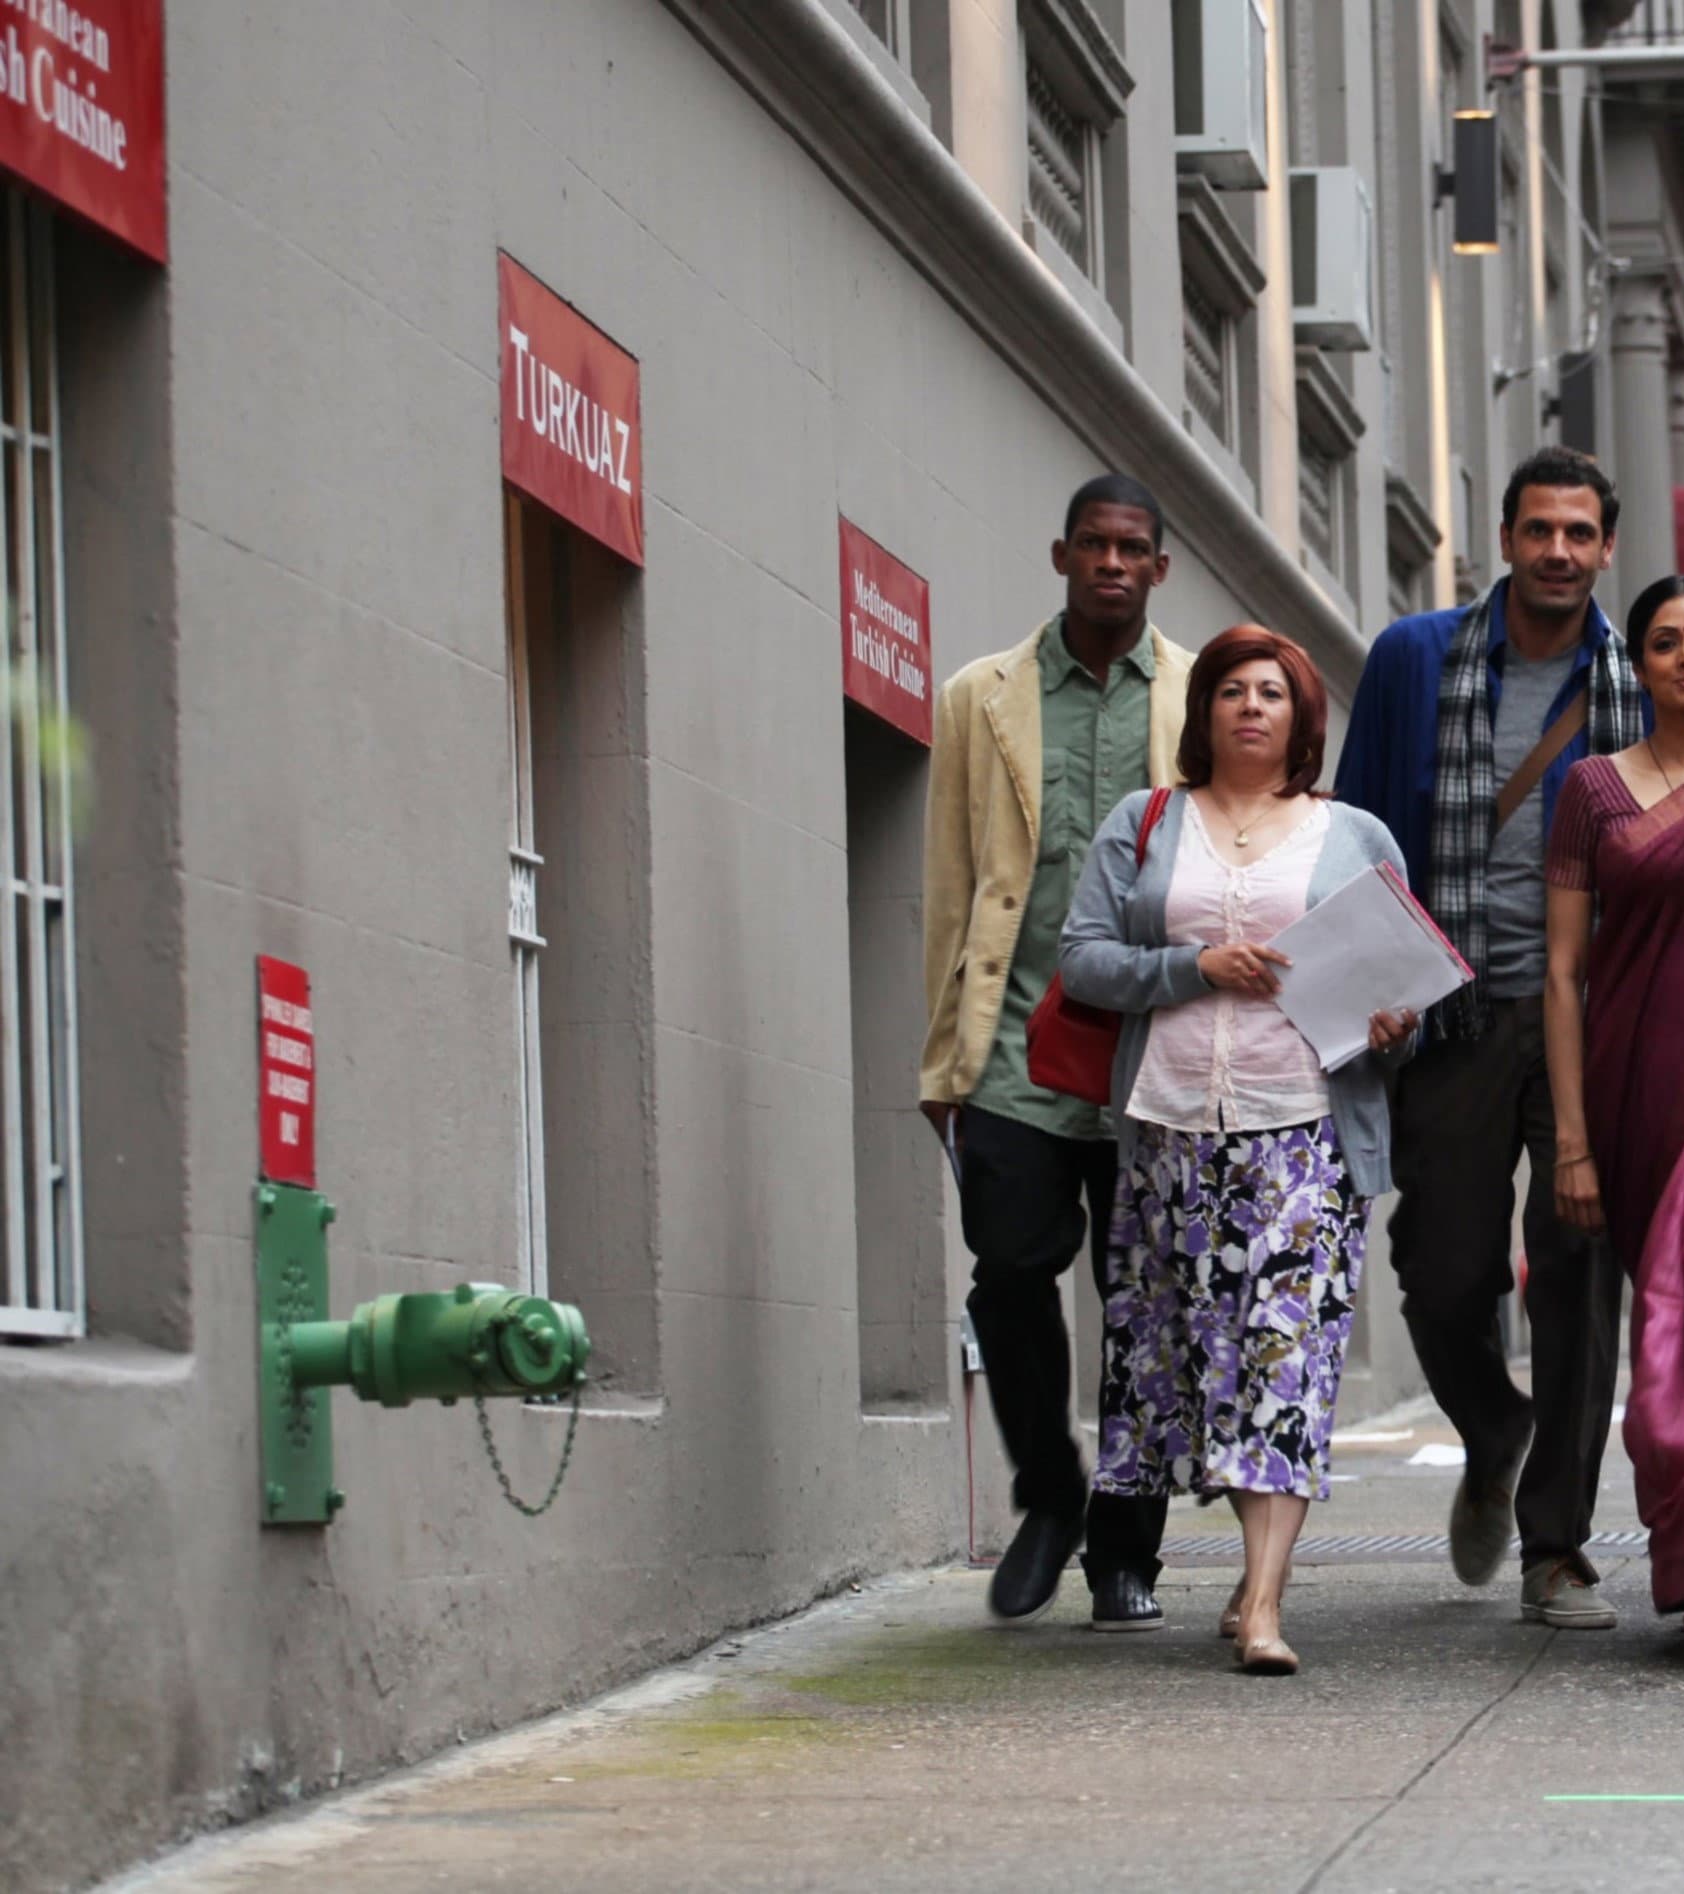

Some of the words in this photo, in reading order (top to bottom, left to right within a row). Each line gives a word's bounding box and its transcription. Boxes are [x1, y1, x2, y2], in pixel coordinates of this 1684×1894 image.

[31, 46, 127, 171] Cuisine
[509, 325, 632, 496] TURKUAZ
[849, 612, 890, 680] Turkish
[890, 641, 926, 702] Cuisine
[853, 568, 919, 646] Mediterranean
